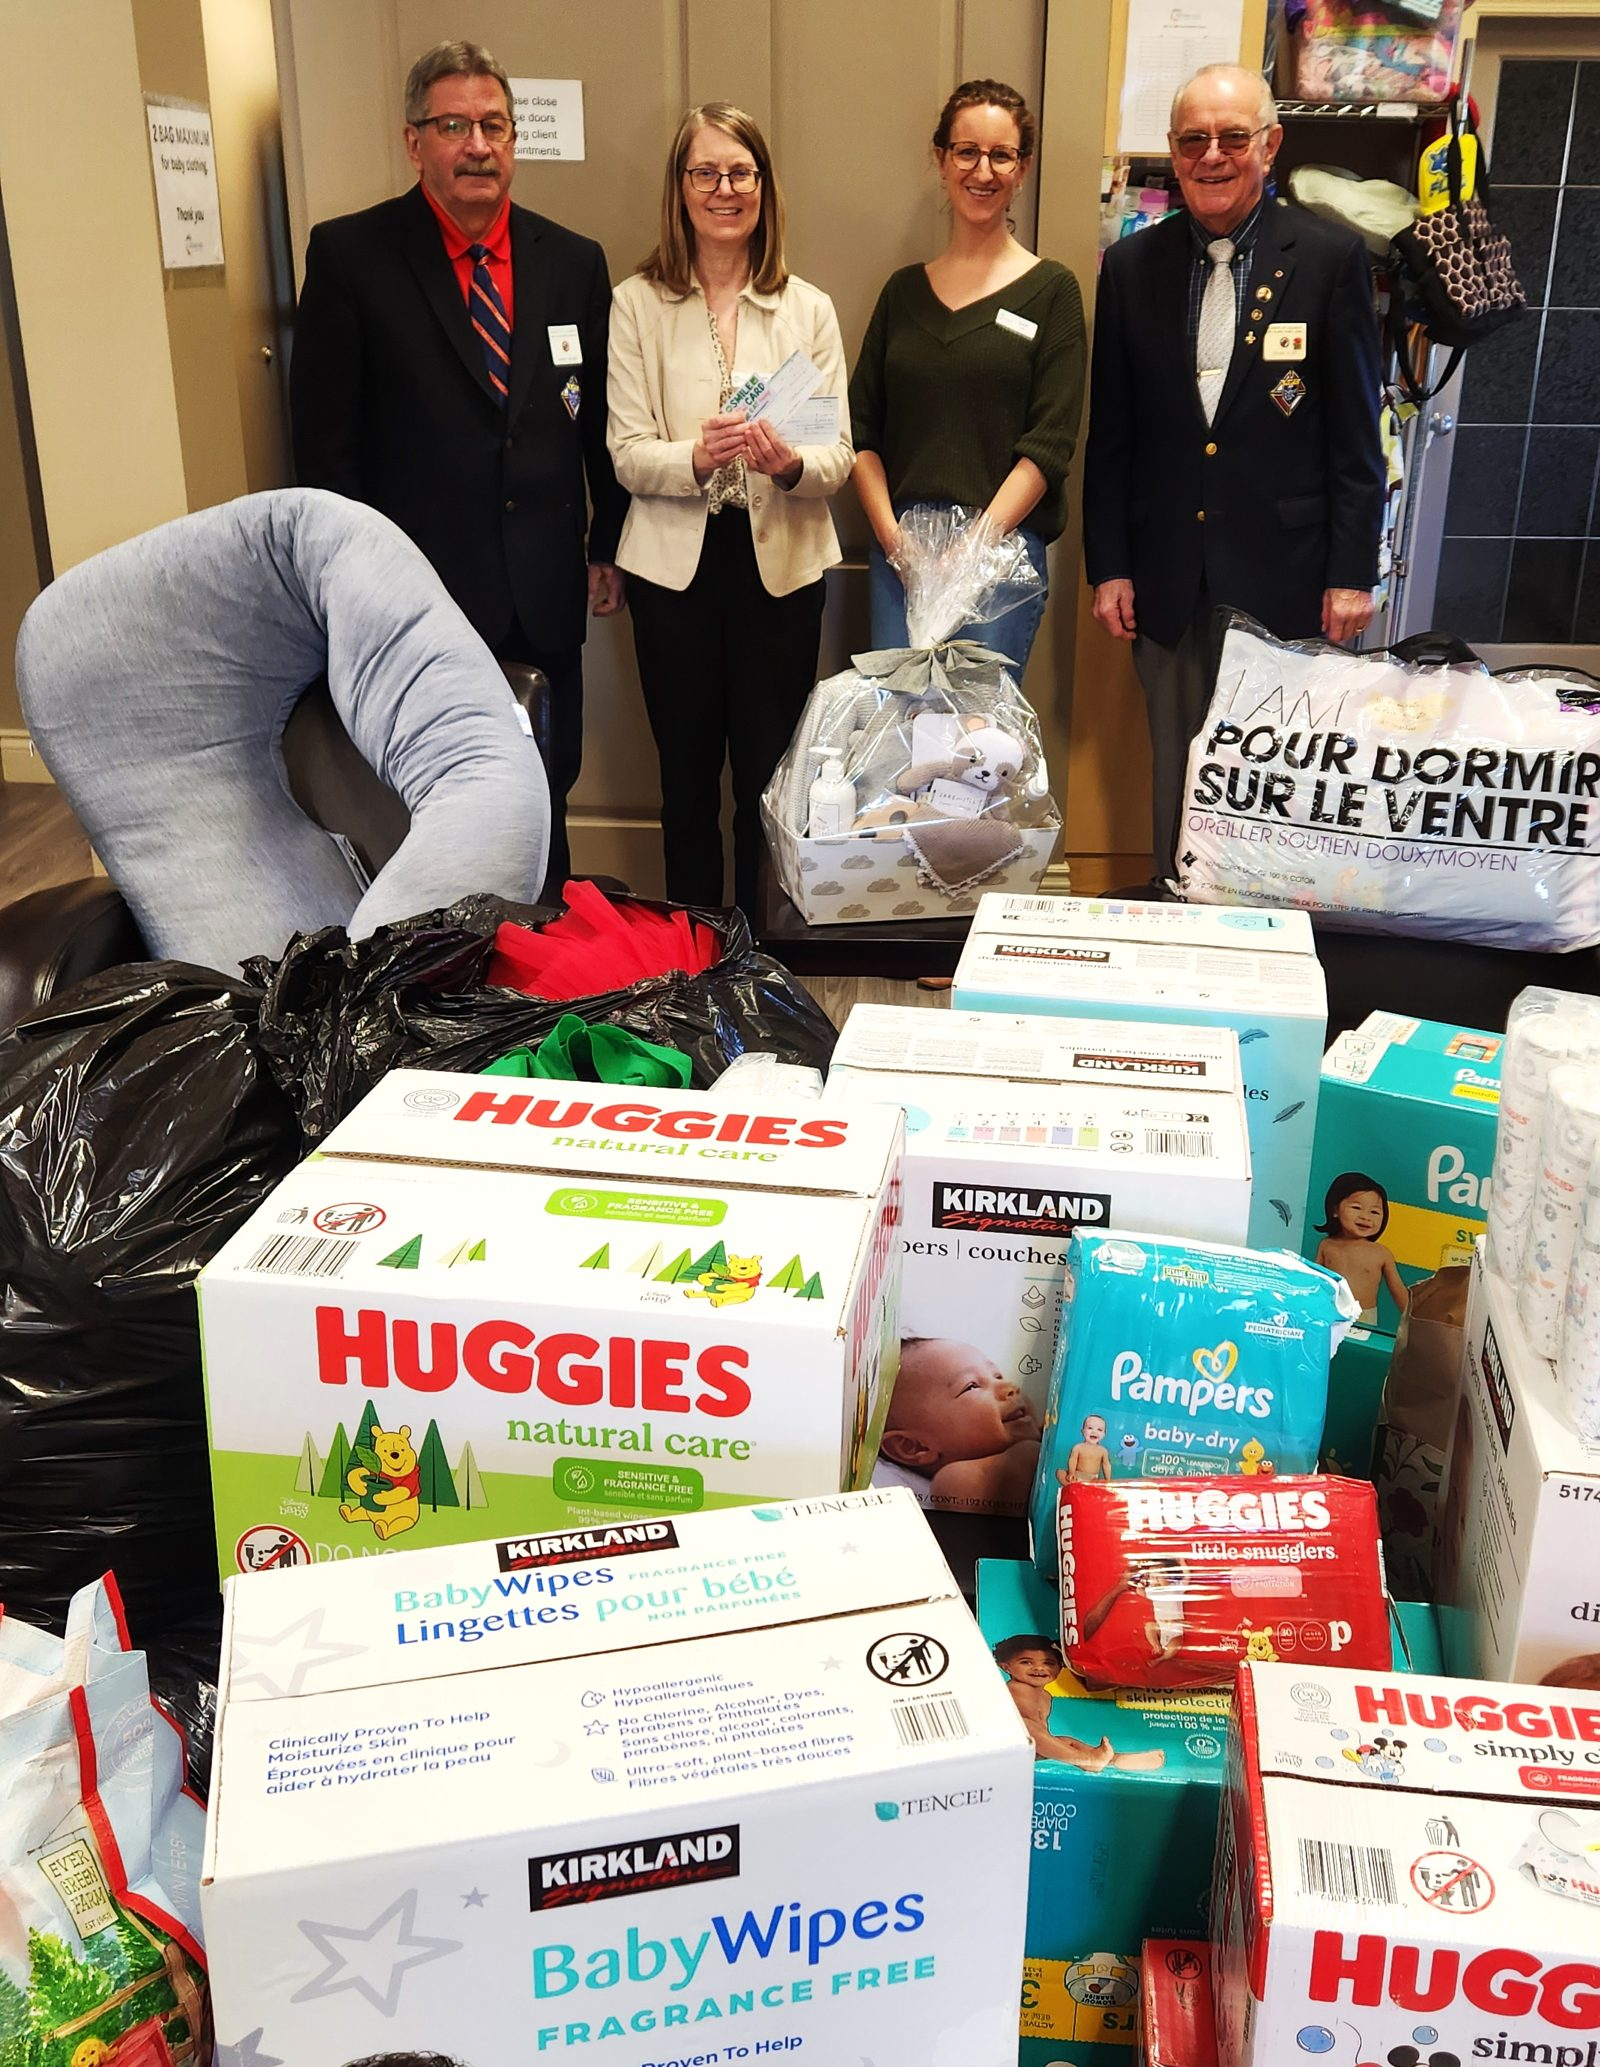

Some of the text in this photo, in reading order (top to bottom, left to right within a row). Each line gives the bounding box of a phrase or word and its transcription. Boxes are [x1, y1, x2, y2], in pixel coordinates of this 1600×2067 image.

[532, 96, 557, 106] close
[528, 113, 556, 123] doors
[152, 124, 158, 143] 2
[159, 125, 175, 144] BAG
[532, 129, 557, 139] client
[161, 154, 186, 174] for baby
[177, 207, 204, 224] Thank you
[730, 381, 753, 408] SMILE
[744, 382, 765, 406] CARD
[1206, 718, 1600, 798] POUR DORMIR
[1193, 763, 1298, 818] SUR
[1309, 780, 1369, 828] LE
[1188, 815, 1519, 872] OREILLER SOUTIEN DOUX/MOYEN
[1290, 875, 1316, 884] COTON
[1238, 889, 1271, 900] FLOCONS
[1312, 902, 1350, 911] POLYESTER
[1001, 945, 1107, 960] KIRKLAND
[1077, 1058, 1200, 1075] KIRKLAND
[453, 1091, 849, 1148] HUGGIES
[552, 1135, 779, 1163] natural care
[607, 1202, 682, 1214] FRAGRANCE
[626, 1198, 689, 1208] SENSITIVE
[943, 1187, 1104, 1221] KIRKLAND
[941, 1210, 1073, 1232] Signatur
[968, 1245, 1067, 1266] couches
[1248, 1324, 1301, 1337] PEDIATRICIAN
[315, 1305, 752, 1418] HUGGIES
[1111, 1350, 1274, 1419] Pampers
[1485, 1329, 1513, 1430] KIRKLAND
[506, 1416, 752, 1461] natural care
[1144, 1422, 1240, 1454] baby-dry
[618, 1470, 679, 1484] SENSITIVE &
[1151, 1464, 1184, 1476] days &
[604, 1478, 694, 1495] FRAGRANCE FREE
[604, 1490, 636, 1498] sensible
[665, 1494, 692, 1504] parfum
[567, 1506, 620, 1518] Plant-based
[783, 1493, 893, 1518] TENCEL
[1126, 1490, 1331, 1532] HUGGIES
[507, 1523, 669, 1560] KIRKLAND
[1190, 1542, 1239, 1561] little
[394, 1552, 788, 1613] BabyWipes FRAGRANCE FREE
[1059, 1504, 1080, 1648] HUGGIES
[396, 1566, 798, 1645] Lingettes pour bébé
[648, 1591, 802, 1622] NON PARFUMÉES
[612, 1672, 724, 1698] Hypoallergenic
[614, 1680, 754, 1708] Hypoallergéniques
[1126, 1692, 1156, 1704] skin
[618, 1717, 639, 1727] No
[643, 1707, 710, 1724] Chlorine,
[784, 1687, 825, 1702] Dyes,
[619, 1701, 801, 1737] Parabens or Phthalates
[1142, 1712, 1226, 1724] protection de la
[1354, 1684, 1600, 1742] HUGGIE
[268, 1710, 490, 1750] Clinically Proven To Help
[621, 1735, 659, 1748] Sans
[664, 1726, 716, 1742] chlore,
[780, 1705, 854, 1724] colorants,
[1178, 1721, 1198, 1730] 100
[1200, 1723, 1210, 1731] %
[268, 1736, 407, 1764] Moisturize Skin
[623, 1723, 805, 1760] parabènes, ni phtalates
[626, 1732, 854, 1777] Ultra-soft, plant-based fibres
[1474, 1740, 1575, 1766] simply
[267, 1736, 517, 1781] Éprouvées en clinique pour
[628, 1746, 852, 1790] Fibres végétales très douces
[266, 1753, 492, 1795] aider à hydrater la peau
[901, 1787, 992, 1818] TENCEL
[48, 1849, 91, 1878] EVER
[170, 1837, 191, 1909] WINNERS
[541, 1832, 734, 1889] KIRKLAND
[61, 1866, 99, 1896] GREEN
[72, 1888, 107, 1916] FARM
[533, 1891, 926, 2001] BabyWipes
[1308, 1929, 1600, 2030] HUGG
[537, 1955, 936, 2051] FRAGRANCE FREE
[1021, 1980, 1040, 2009] 3
[1082, 1998, 1117, 2006] BLOWOUT
[1024, 2021, 1055, 2030] ACTIVE
[722, 2035, 803, 2061] To Help
